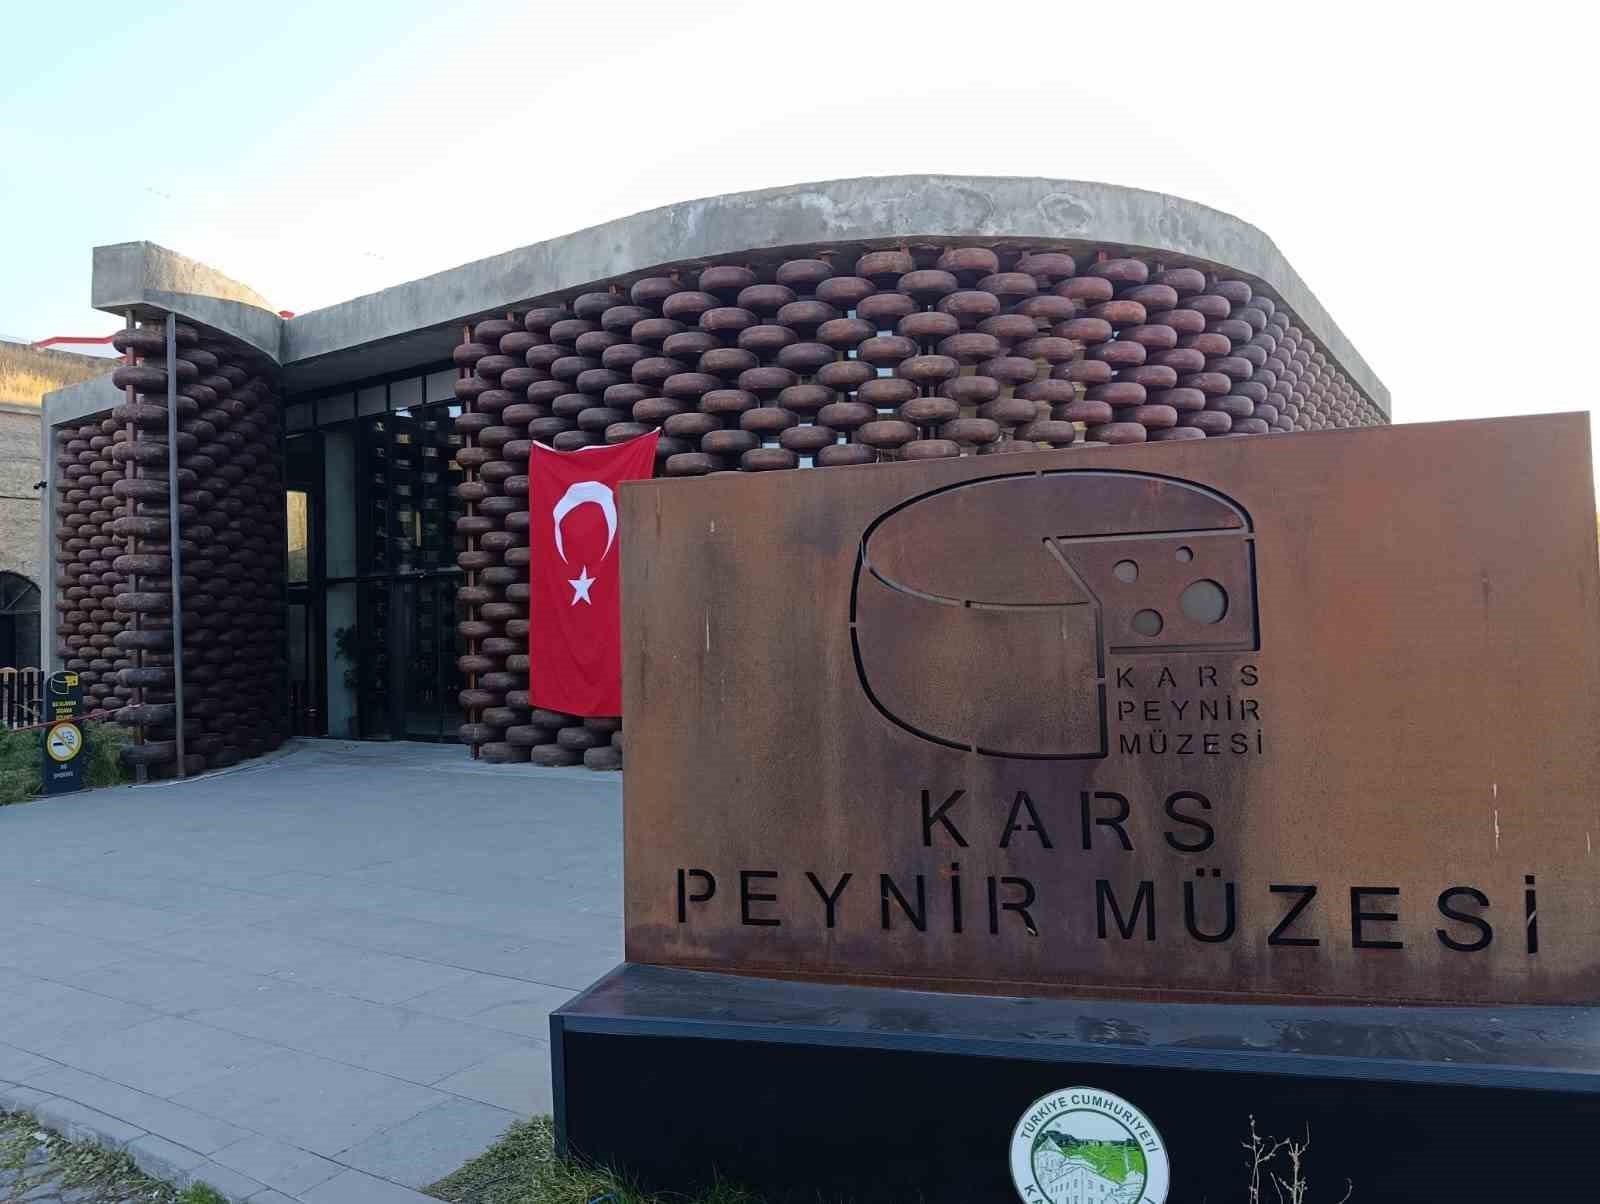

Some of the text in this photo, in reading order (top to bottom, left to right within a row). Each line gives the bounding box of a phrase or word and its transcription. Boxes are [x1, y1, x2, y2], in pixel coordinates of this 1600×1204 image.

[1116, 665, 1259, 688] KARS
[1118, 695, 1261, 721] PEYNİR
[1119, 729, 1262, 755] MÜZESİ
[921, 789, 1215, 853] KARS
[676, 861, 1539, 955] PEYNİR MÜZESİ
[1021, 1094, 1161, 1153] TÜRKİYE CUMHURİYETİ
